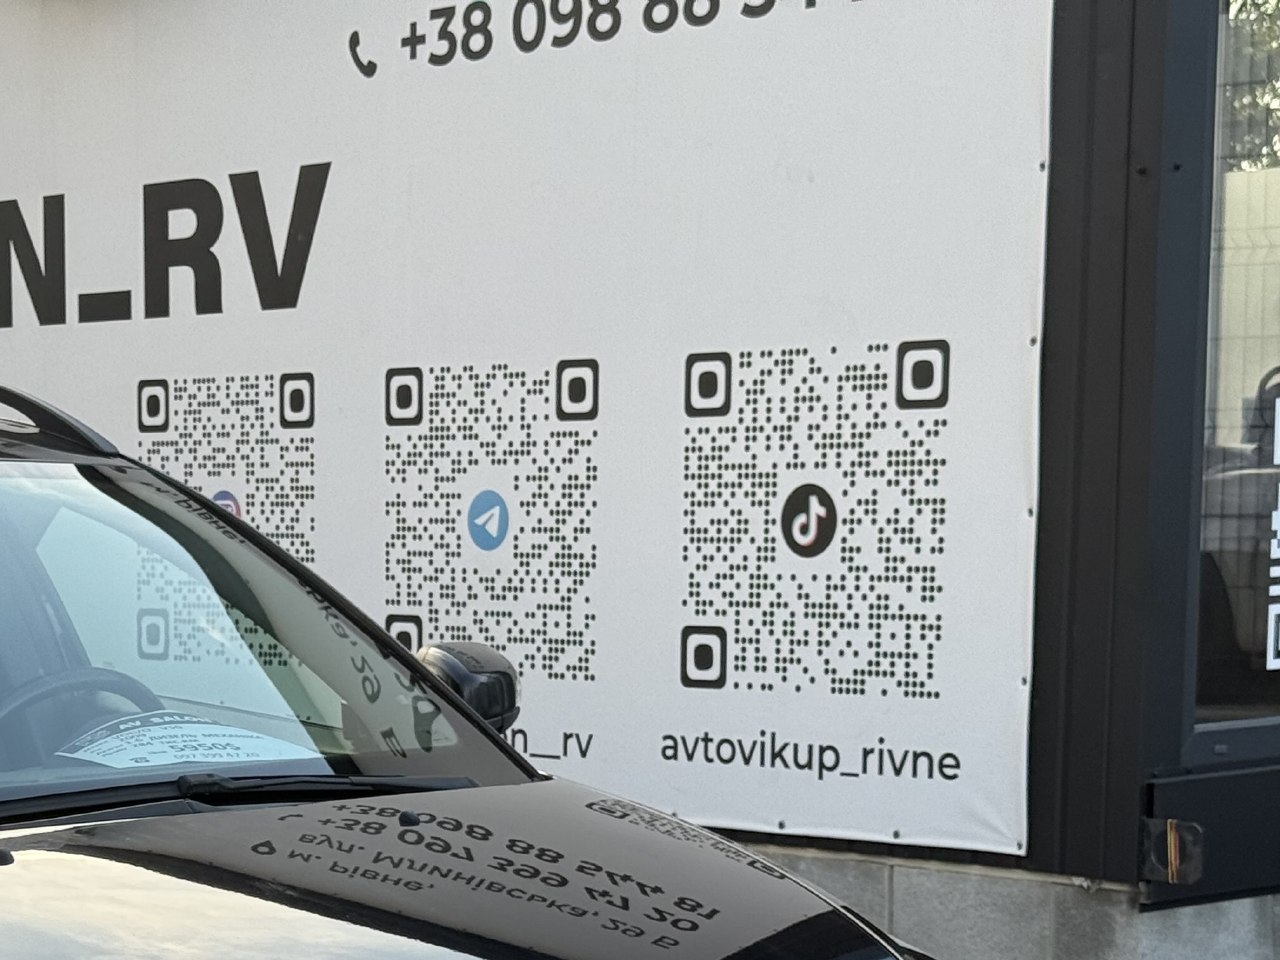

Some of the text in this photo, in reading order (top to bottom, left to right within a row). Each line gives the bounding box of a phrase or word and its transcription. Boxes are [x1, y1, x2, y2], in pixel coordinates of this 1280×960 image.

[400, 0, 494, 66] +38
[512, 0, 621, 53] 098
[502, 728, 594, 759] n_rv
[660, 729, 962, 780] avtovikup_rivne
